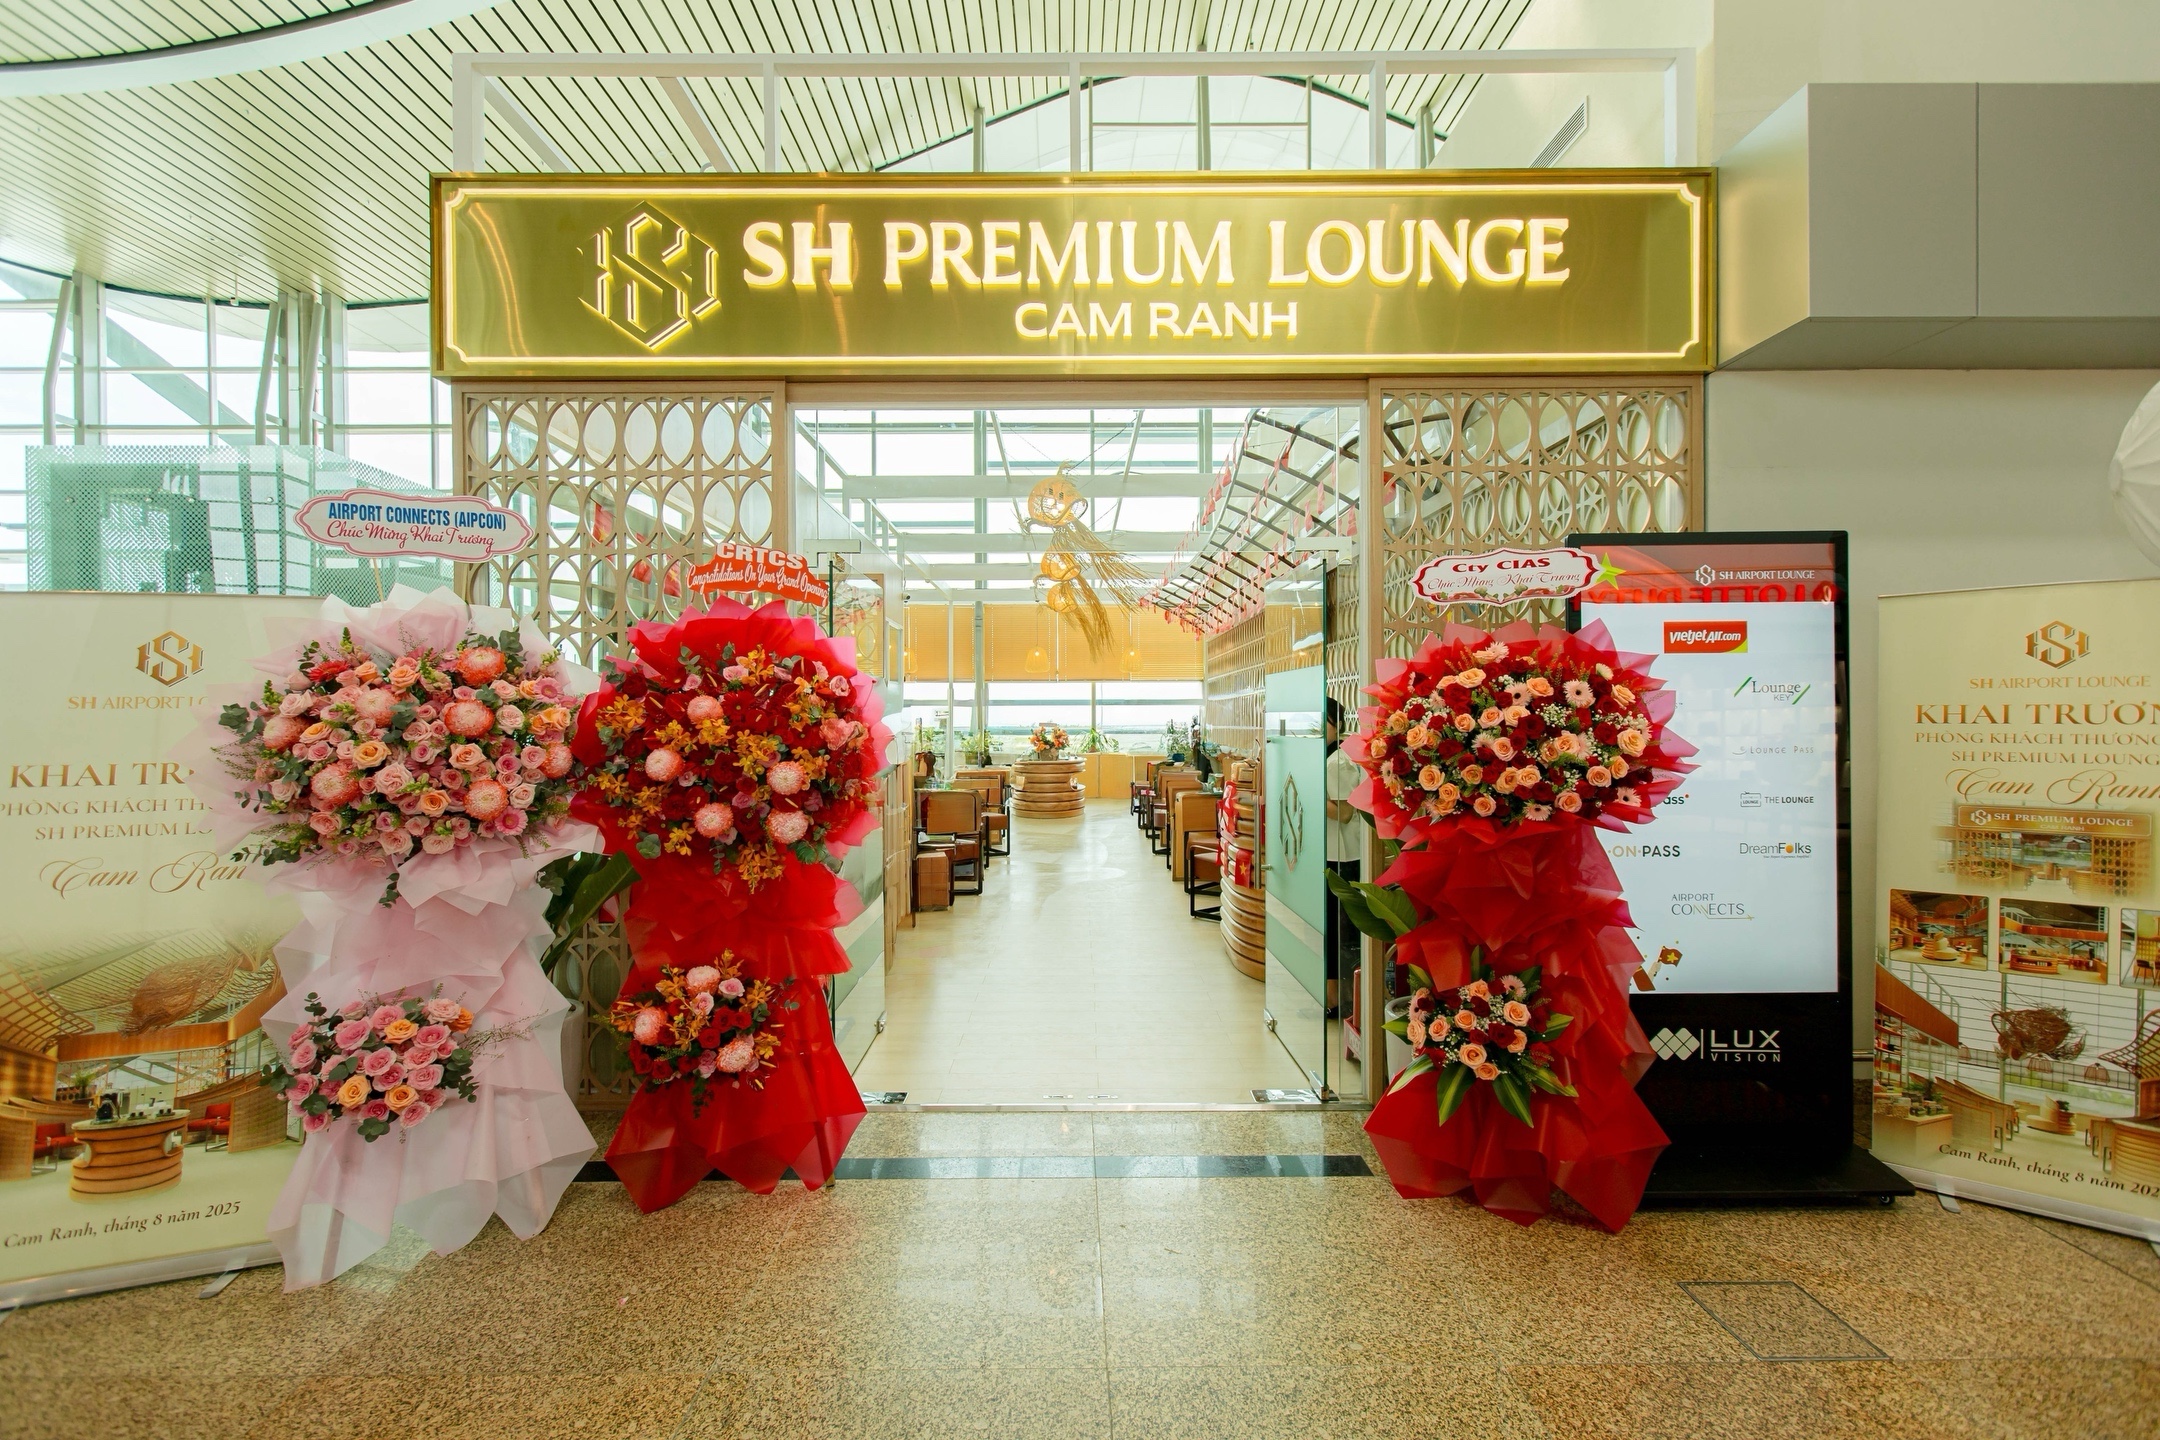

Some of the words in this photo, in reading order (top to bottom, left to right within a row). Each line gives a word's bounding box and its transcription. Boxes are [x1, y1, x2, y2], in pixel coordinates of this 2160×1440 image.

[743, 221, 853, 287] SH
[884, 219, 1234, 288] PREMIUM
[1267, 218, 1571, 287] LOUNGE
[1015, 302, 1132, 340] CAM
[1148, 302, 1298, 340] RANH
[328, 502, 382, 522] AIRPORT
[386, 506, 450, 527] CONNECTS
[454, 511, 506, 532] (AIPCON)
[327, 520, 363, 538] Chúc
[410, 524, 444, 542] Khai
[716, 543, 804, 569] CRTCS
[1452, 563, 1489, 573] Cty
[1496, 557, 1551, 570] CIAS
[1719, 571, 1734, 580] SH
[1735, 570, 1776, 580] AIRPORT
[1777, 570, 1815, 579] LOUNGE
[686, 562, 744, 595] Congratulations
[744, 562, 757, 583] On
[757, 563, 776, 588] Your
[776, 566, 801, 590] Grand
[800, 572, 828, 607] Opening
[1751, 680, 1802, 696] Lounge
[1970, 678, 1994, 689] SH
[1998, 676, 2073, 689] AIRPORT
[2077, 675, 2151, 688] LOUNGE
[67, 696, 97, 709] SH
[102, 696, 186, 709] AIRPORT
[1914, 703, 2011, 725] KHAI
[1914, 730, 1984, 744] PHÒNG
[1989, 730, 2063, 745] KHÁCH
[1750, 745, 1787, 754] LOUNGE
[1951, 750, 1975, 762] SH
[1982, 751, 2076, 764] PREMIUM
[9, 763, 119, 788] KHAI
[1945, 767, 2036, 802] Cam
[87, 797, 167, 814] KHÁCH
[1765, 796, 1779, 804] THE
[1781, 796, 1814, 804] LOUNGE
[1993, 812, 2011, 821] SH
[2014, 813, 2075, 824] PREMIUM
[2079, 816, 2134, 827] LOUNGE
[35, 826, 65, 840] SH
[73, 823, 178, 839] PREMIUM
[39, 857, 140, 901] Cam
[1671, 893, 1715, 902] AIRPORT
[1671, 903, 1745, 916] CONNECTS
[1710, 1029, 1781, 1048] LUX
[1710, 1052, 1781, 1063] VISION
[1938, 1143, 1972, 1160] Cam
[1976, 1150, 2021, 1172] Ranh,
[2026, 1162, 2070, 1183] tháng
[2074, 1172, 2084, 1182] 8
[2090, 1177, 2125, 1191] năm
[3, 1232, 43, 1248] Cam
[50, 1223, 97, 1243] Ranh,
[103, 1213, 148, 1233] tháng
[153, 1213, 163, 1225] 8
[167, 1209, 201, 1224] năm
[204, 1201, 242, 1219] 2025
